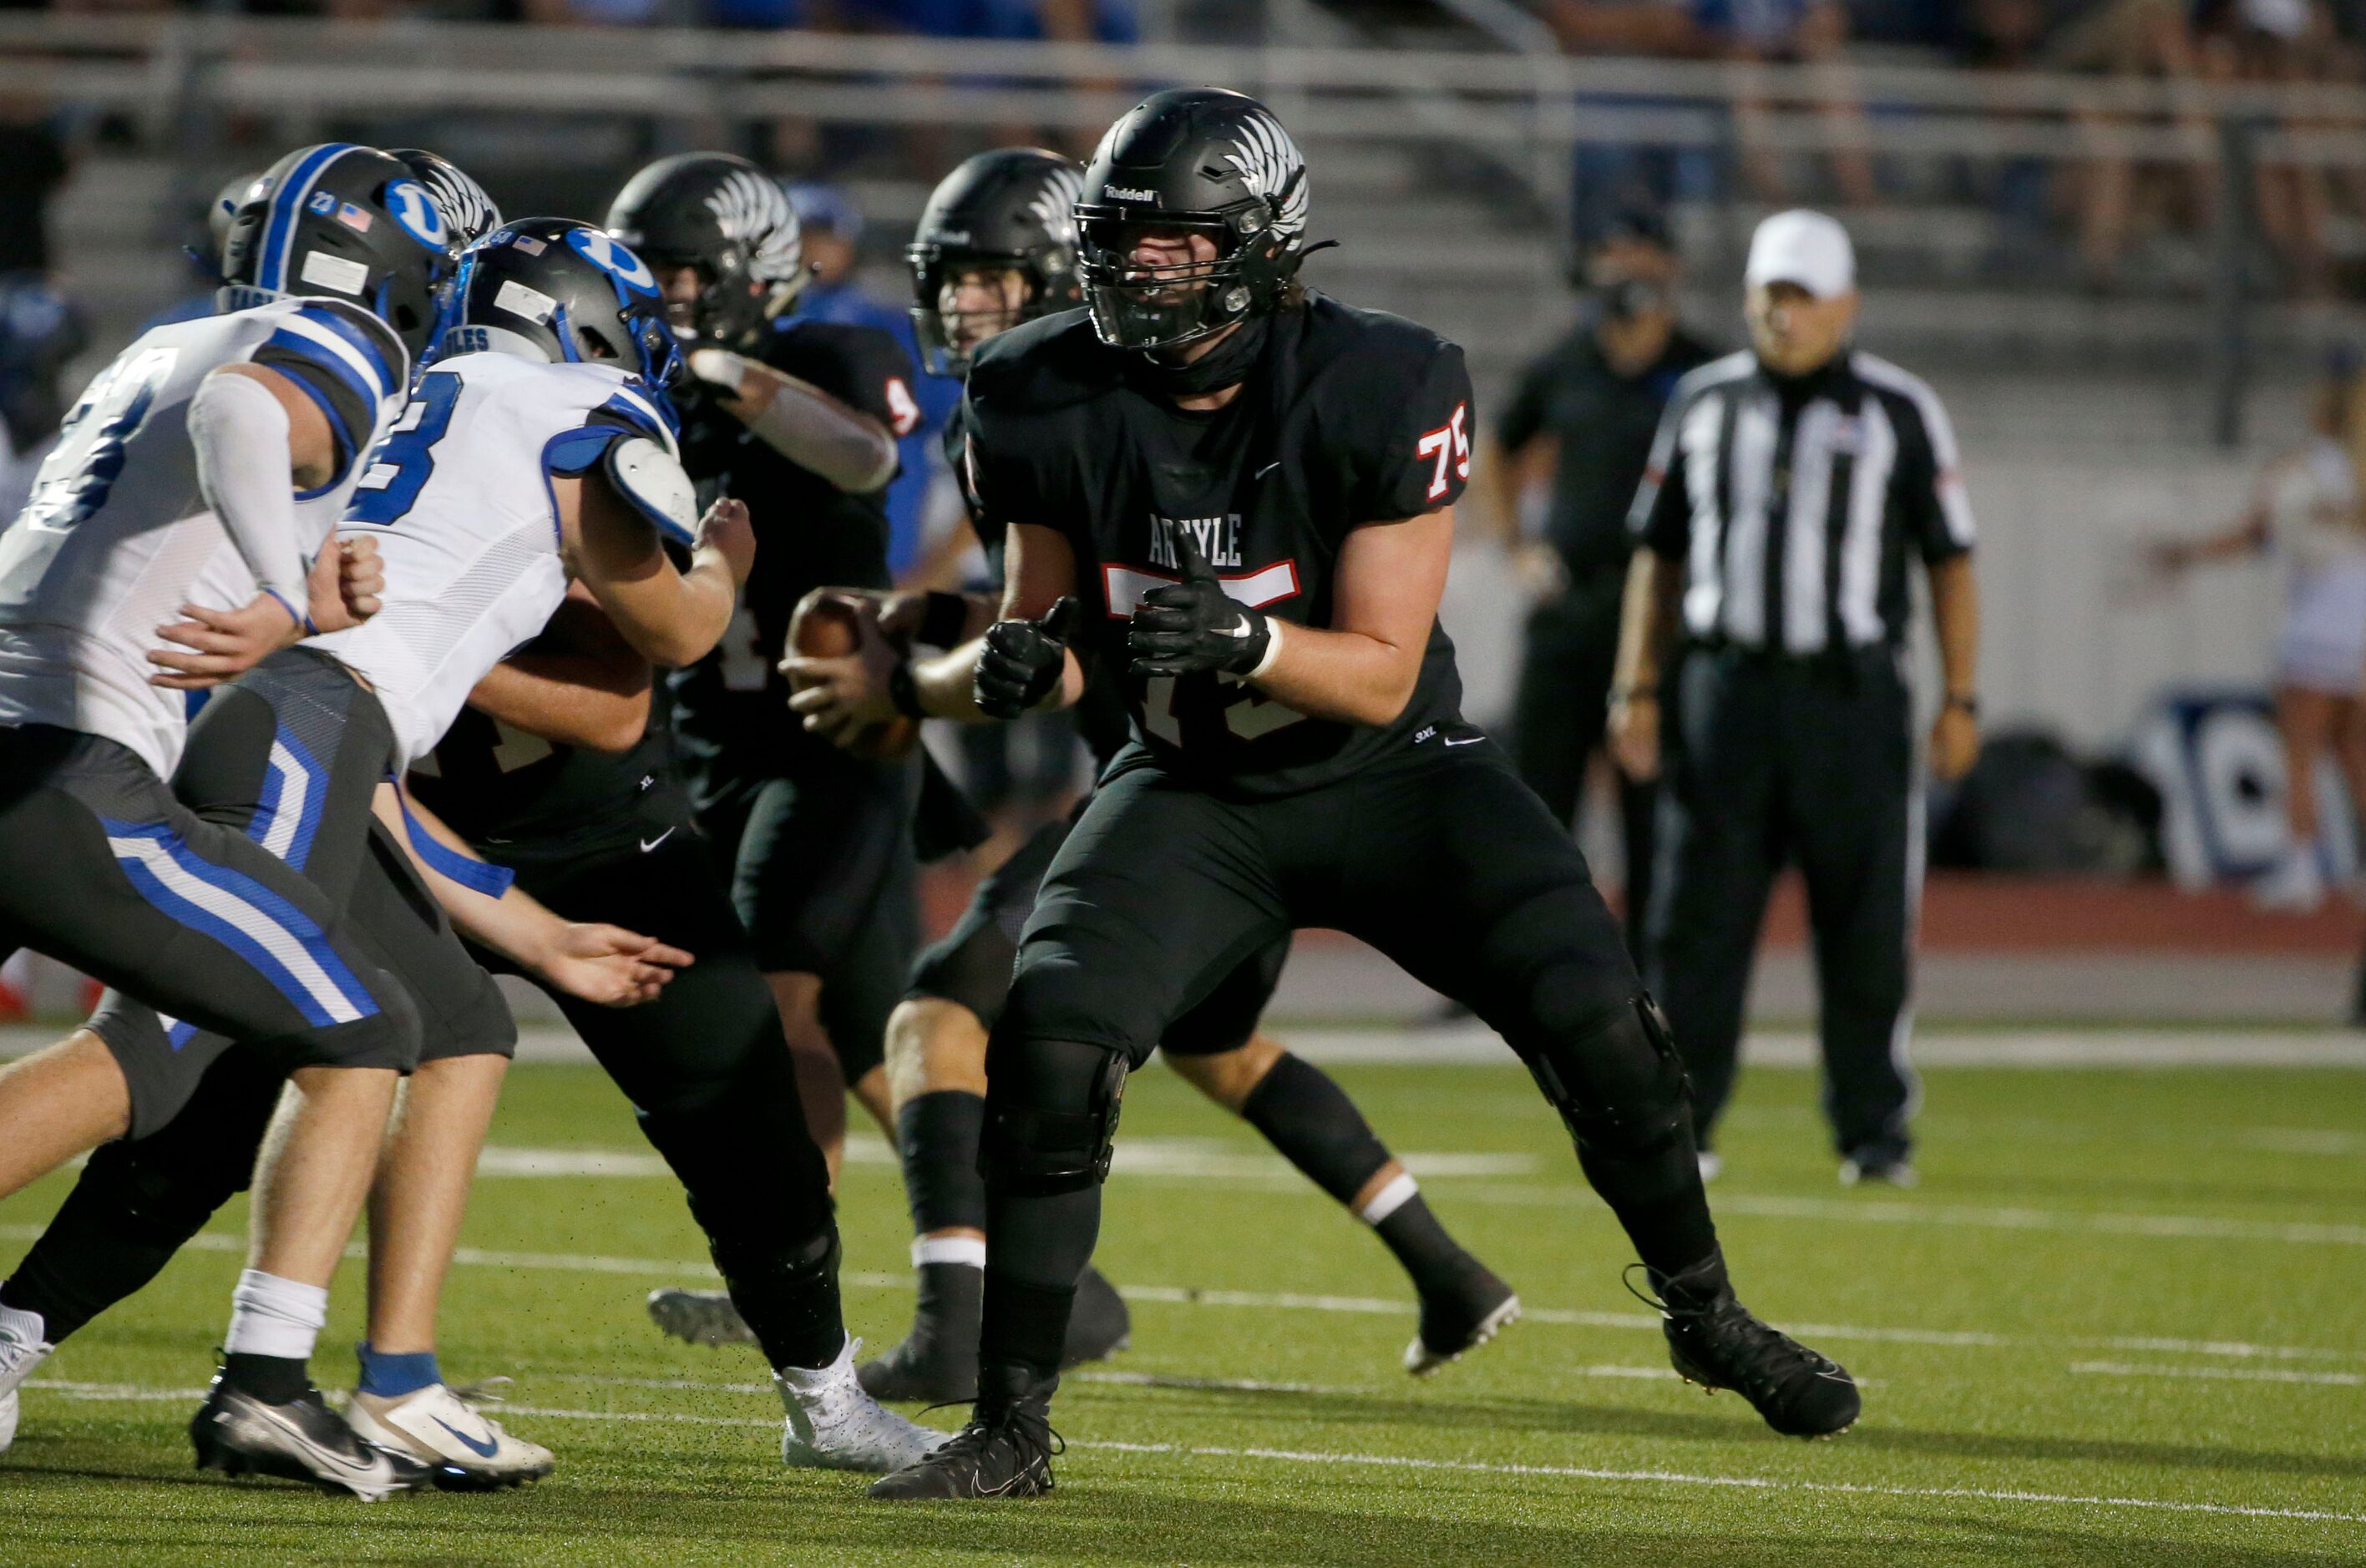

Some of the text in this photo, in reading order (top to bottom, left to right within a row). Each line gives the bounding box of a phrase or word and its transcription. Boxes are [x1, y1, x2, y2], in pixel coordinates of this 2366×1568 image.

[1105, 185, 1154, 202] Riddell
[1416, 400, 1470, 503] 75
[1148, 513, 1242, 569] ARYLE
[1414, 726, 1436, 744] 3XL
[640, 775, 655, 791] XL
